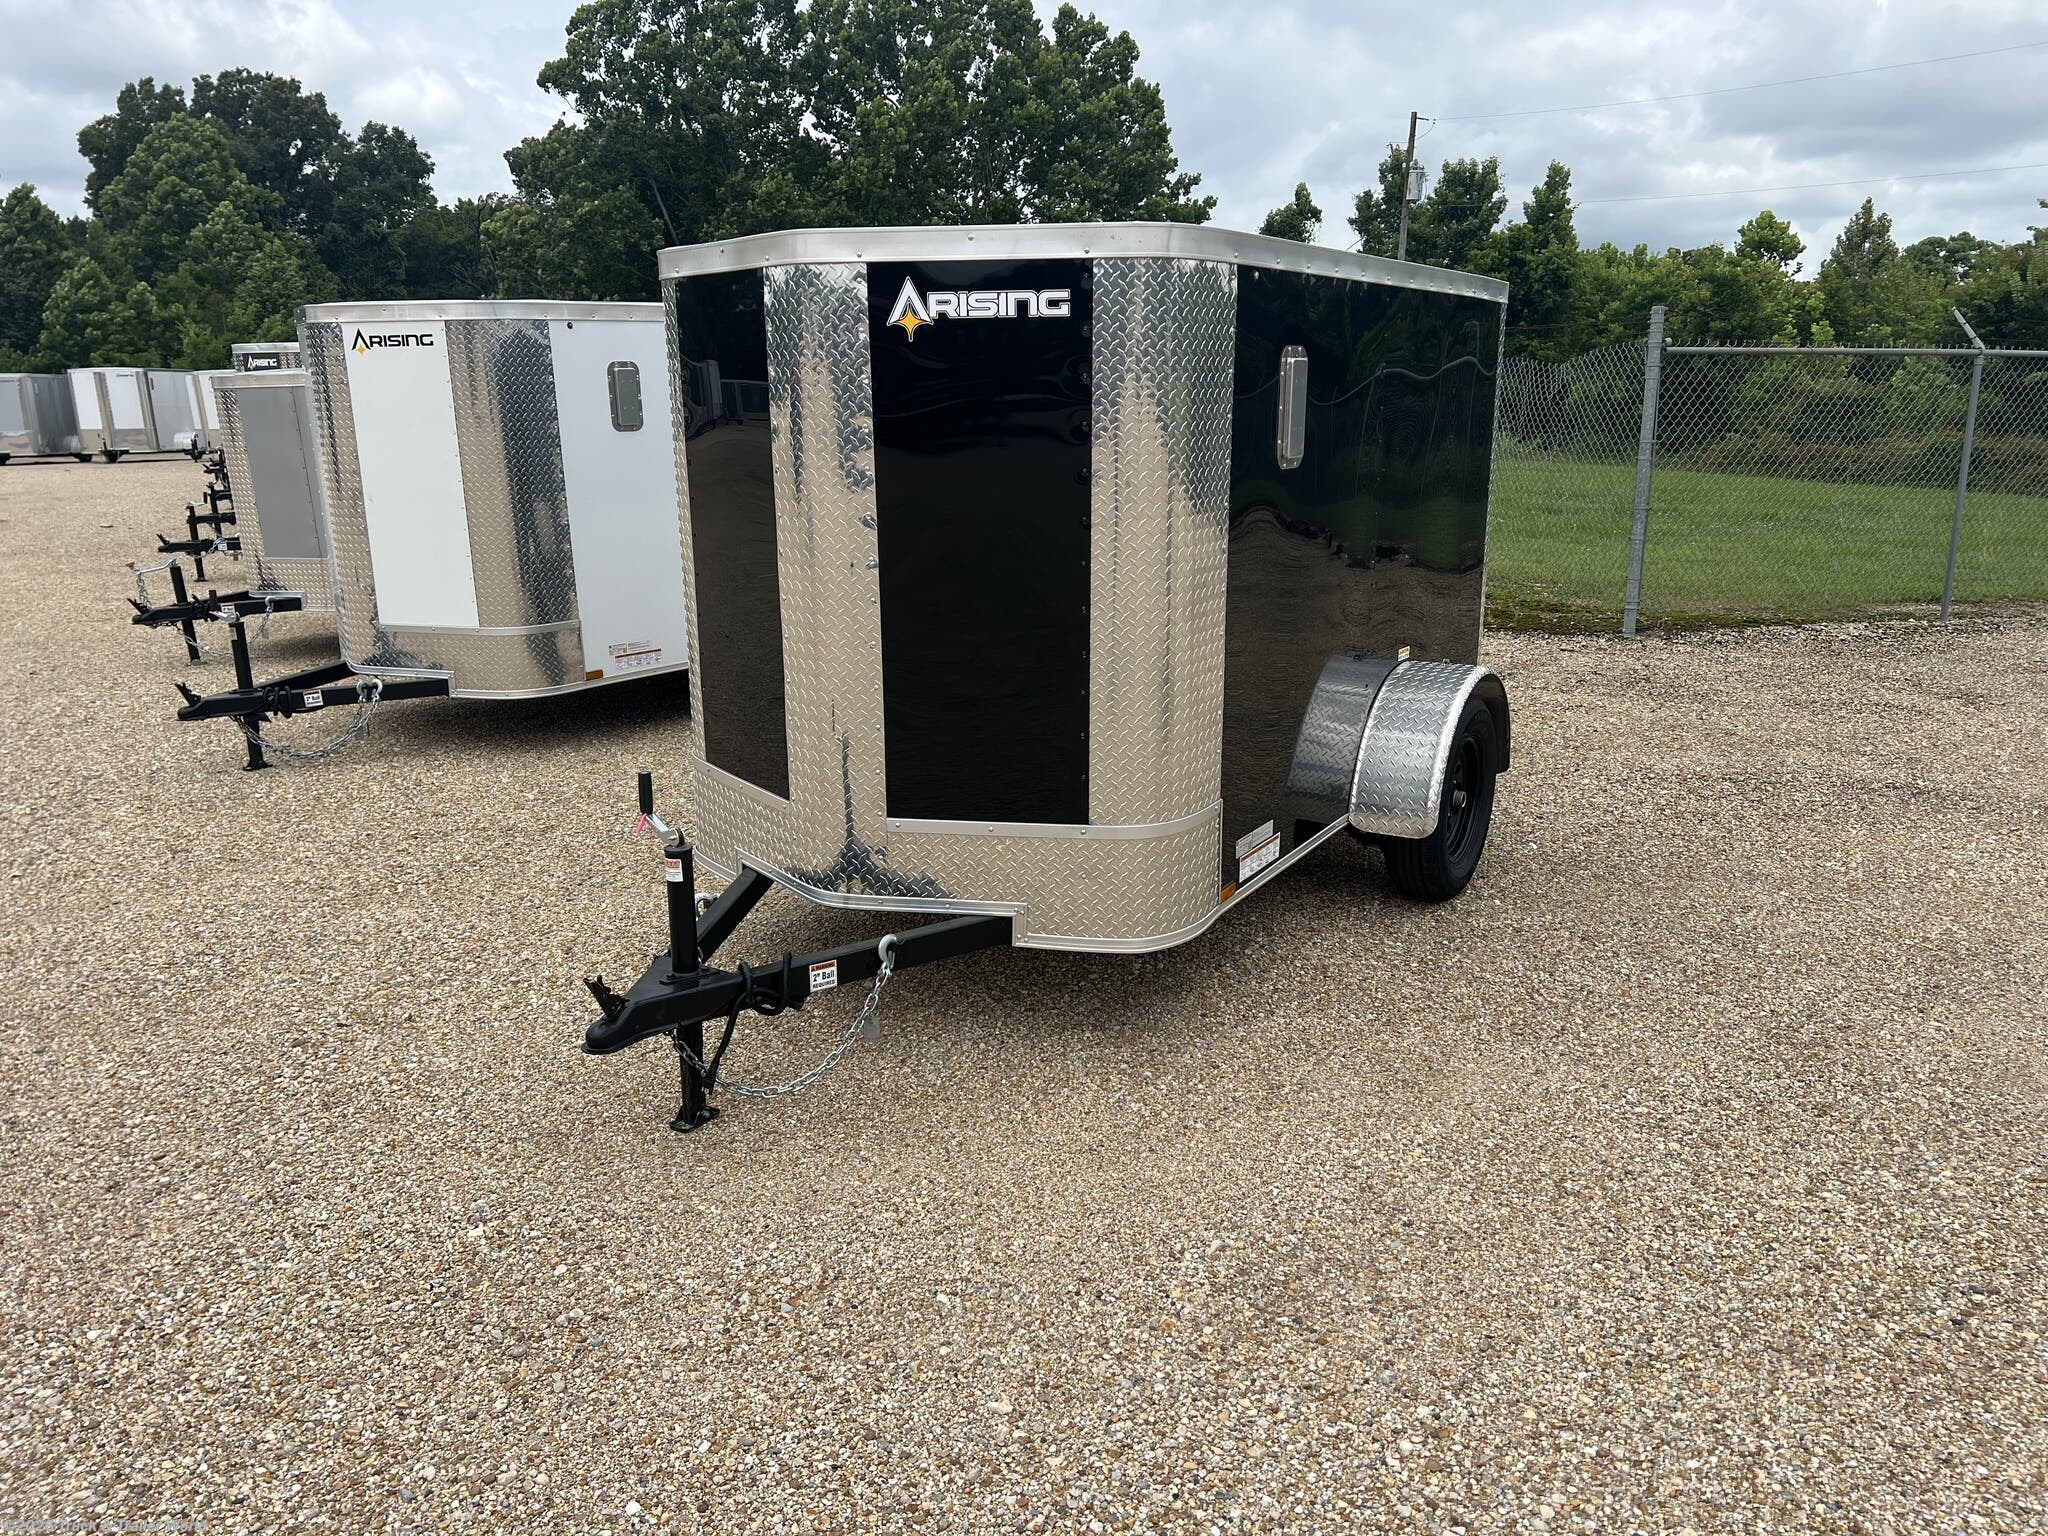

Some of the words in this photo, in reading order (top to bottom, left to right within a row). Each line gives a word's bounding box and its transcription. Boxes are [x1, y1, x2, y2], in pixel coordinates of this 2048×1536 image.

[886, 276, 1071, 328] ARISING
[352, 328, 434, 351] ARISING
[812, 973, 821, 982] 2"
[822, 969, 835, 980] Ball
